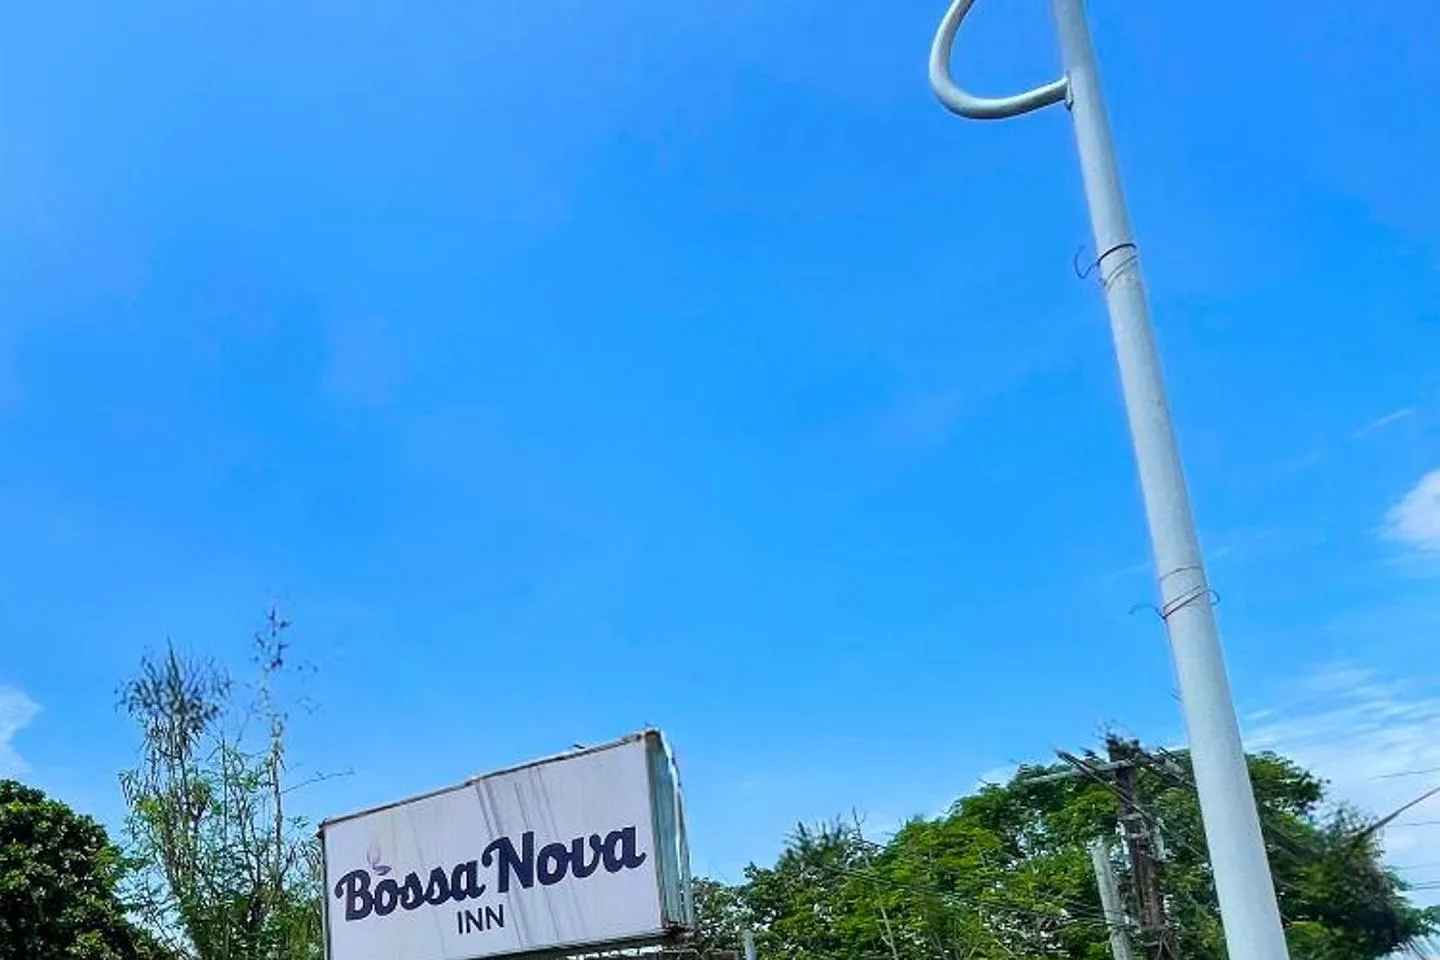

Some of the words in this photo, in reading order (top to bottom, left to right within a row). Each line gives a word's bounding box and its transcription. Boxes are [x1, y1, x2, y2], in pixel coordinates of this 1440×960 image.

[334, 859, 486, 921] Bossa
[482, 826, 647, 893] Nova
[457, 904, 505, 934] INN
